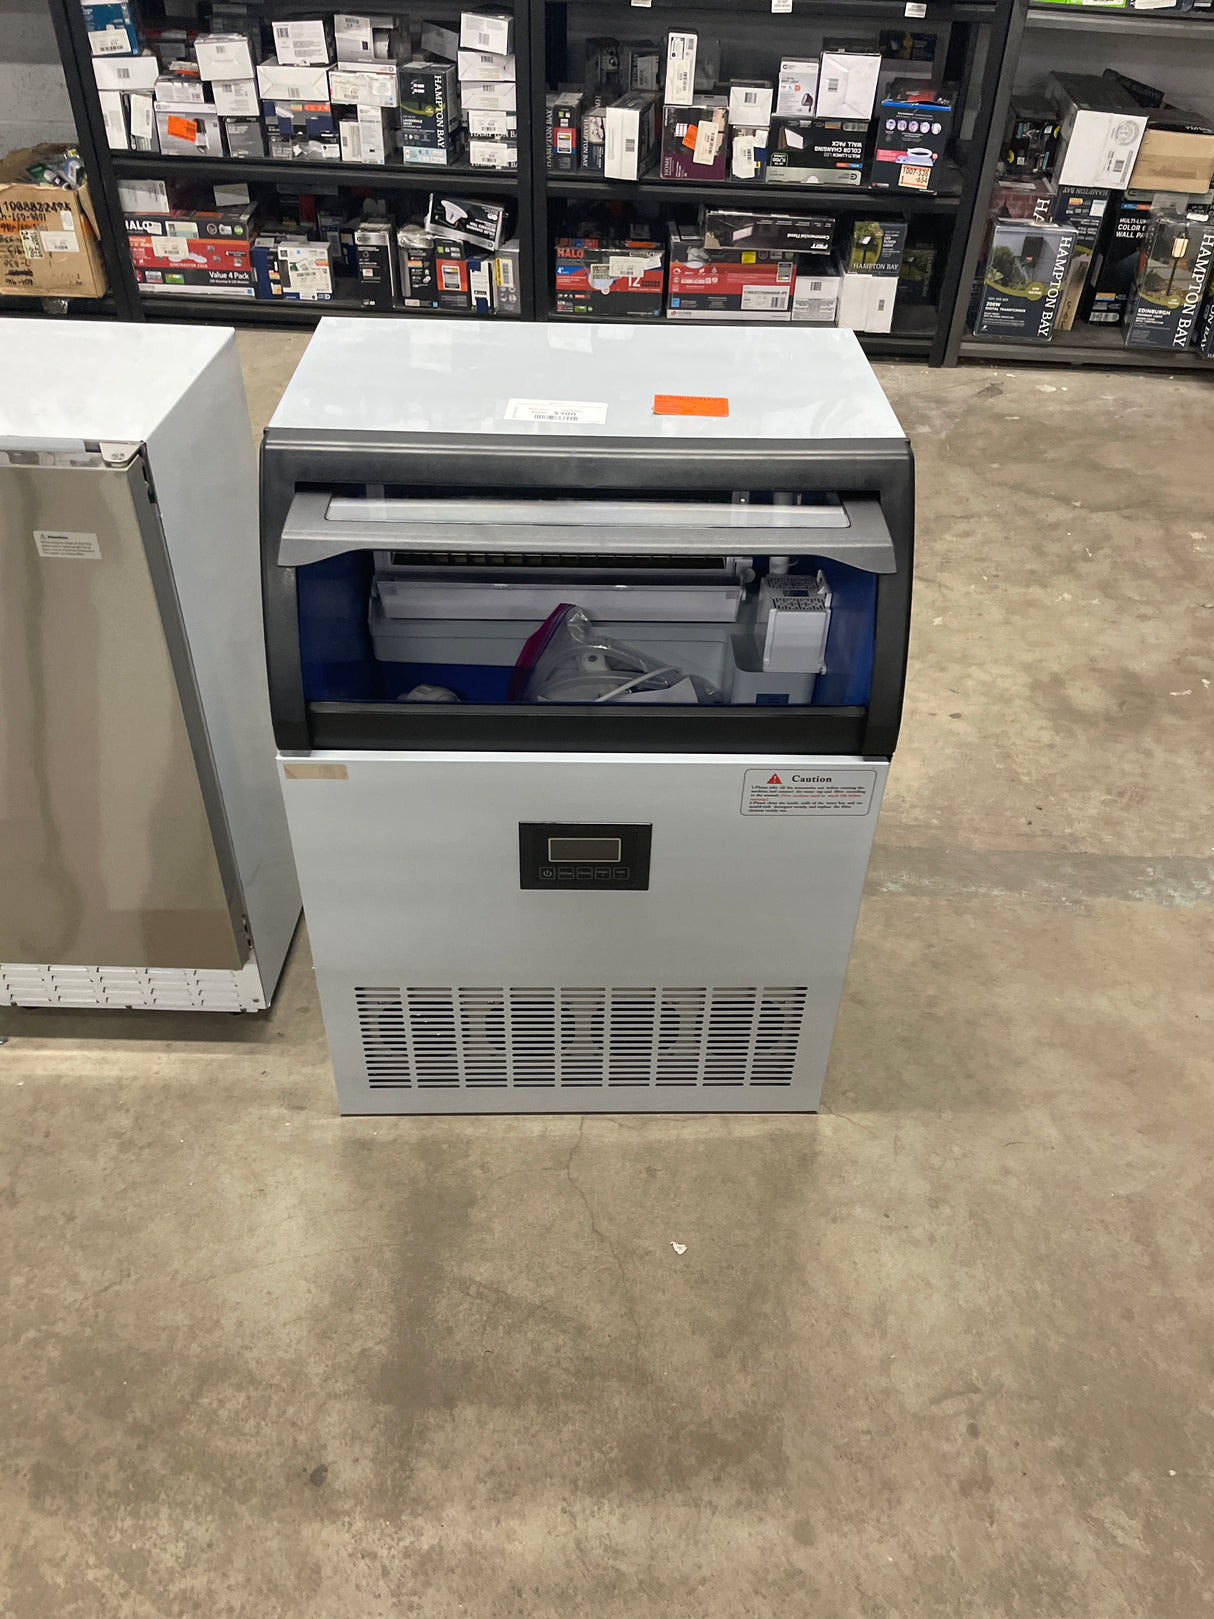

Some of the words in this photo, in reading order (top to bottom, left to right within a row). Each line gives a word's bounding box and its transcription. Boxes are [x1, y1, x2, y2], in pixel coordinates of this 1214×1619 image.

[434, 75, 444, 127] HAMPTON
[437, 130, 445, 148] BAY
[1062, 186, 1076, 194] BAY
[1077, 187, 1108, 196] HAMPTON
[1117, 224, 1141, 232] COLOR
[557, 248, 584, 258] HALO
[209, 271, 228, 280] Value
[229, 272, 234, 280] 4
[234, 272, 249, 280] Pack
[1044, 236, 1073, 308] HAMPTON
[1182, 233, 1214, 316] HAMPTON
[1138, 308, 1171, 316] EDINBURGH
[1037, 311, 1053, 336] BAY
[1172, 318, 1192, 347] BAY
[1201, 326, 1210, 351] BAY
[791, 775, 832, 783] Caution
